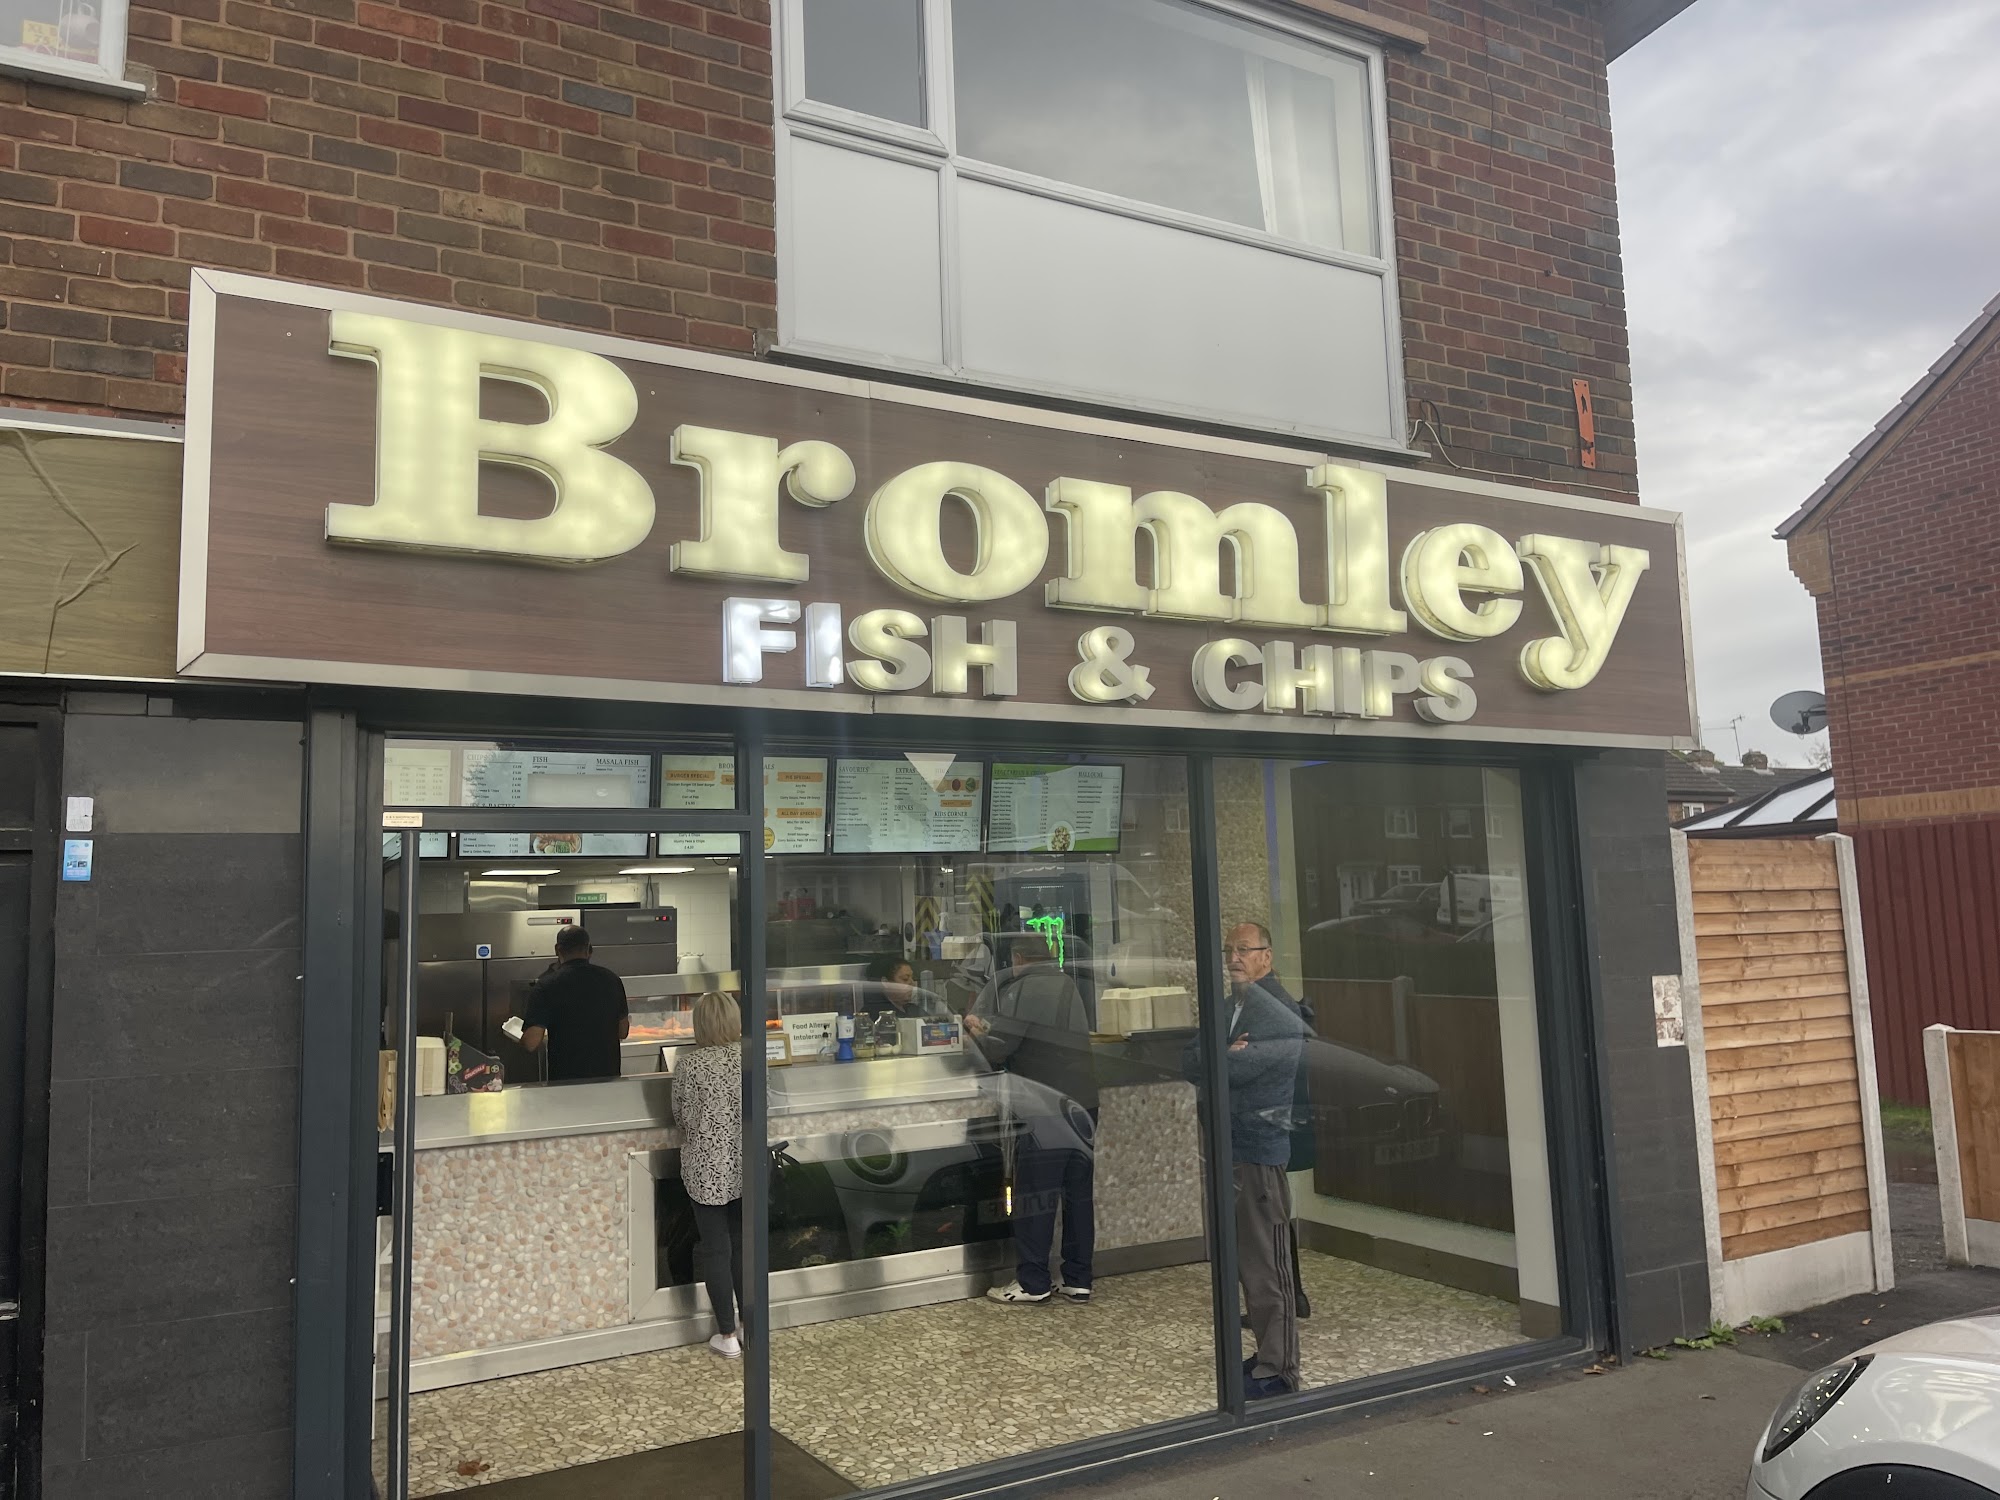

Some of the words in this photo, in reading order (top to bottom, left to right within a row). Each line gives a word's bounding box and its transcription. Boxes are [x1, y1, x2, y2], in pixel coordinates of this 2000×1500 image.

[324, 308, 1650, 692] Bromley
[722, 596, 1018, 697] FISH
[1067, 625, 1156, 705] &
[1191, 637, 1477, 723] CHIPS
